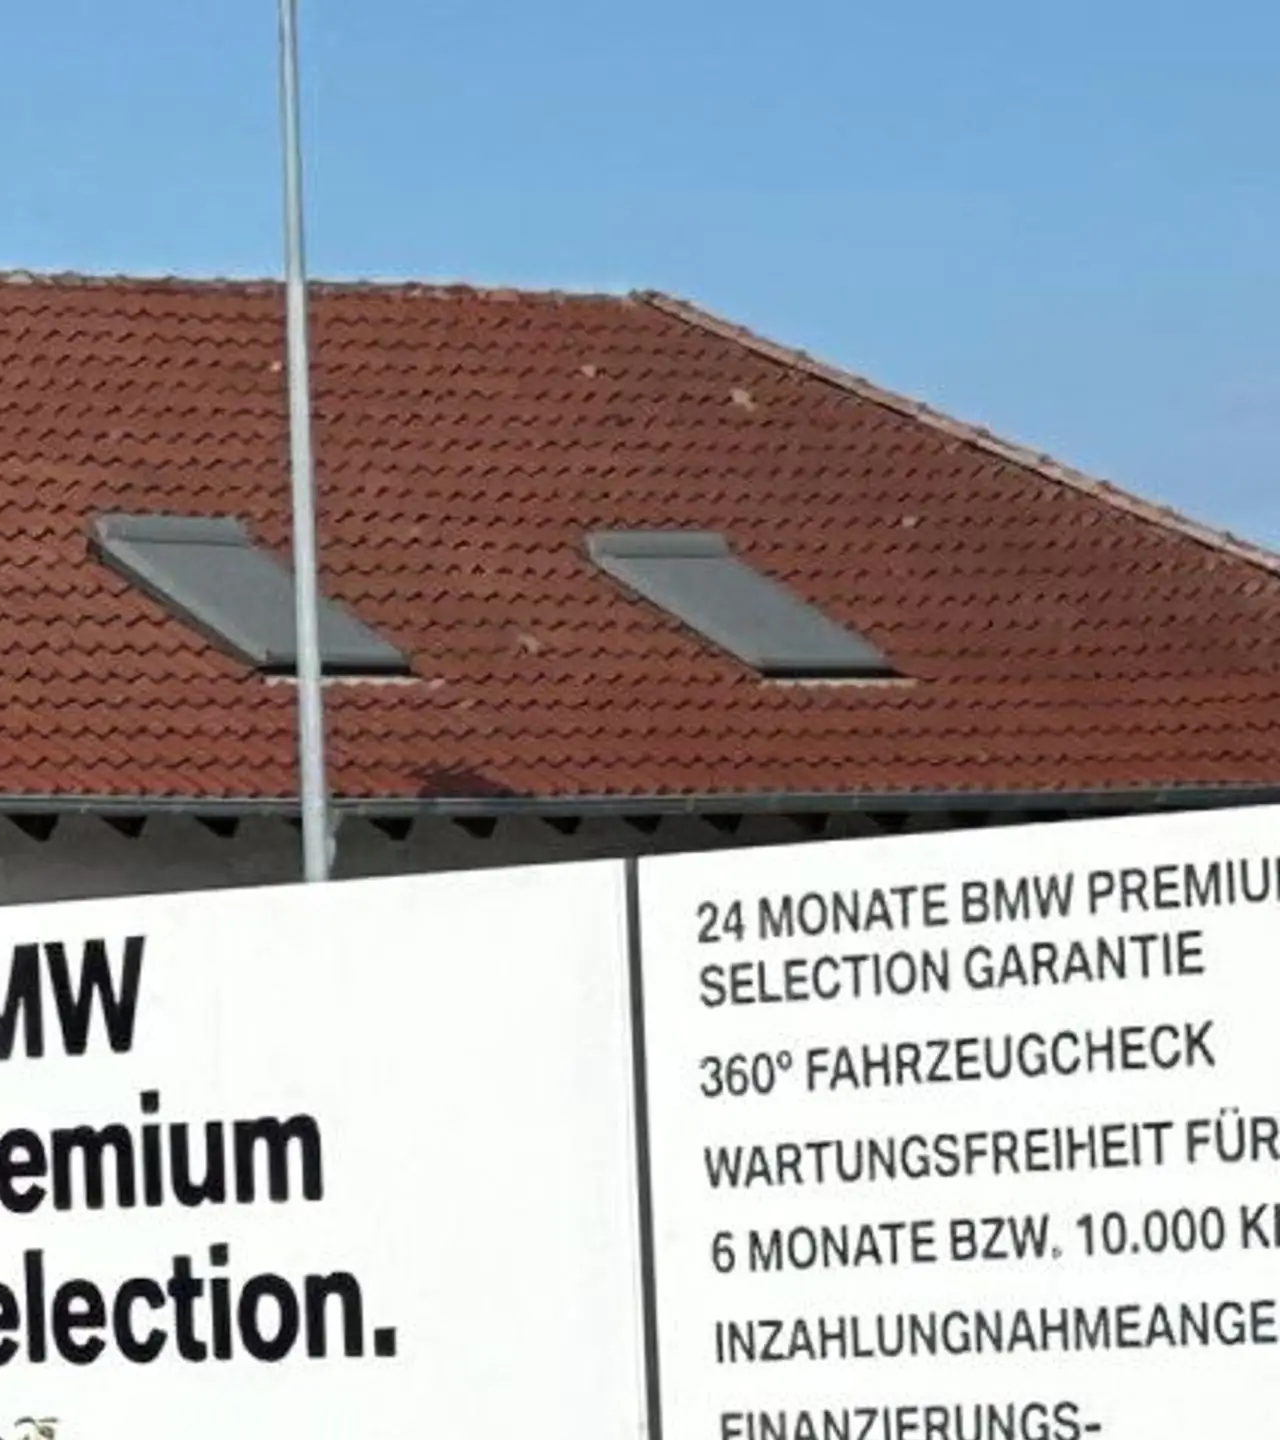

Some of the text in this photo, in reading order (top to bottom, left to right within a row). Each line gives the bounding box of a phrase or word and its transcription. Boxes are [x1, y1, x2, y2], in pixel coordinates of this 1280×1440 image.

[697, 856, 1280, 943] 24 MONATE BMW PREMIU
[700, 930, 1206, 1008] SELECTION GARANTIE
[807, 1020, 1216, 1092] FAHRZEUGCHECK
[704, 1107, 1280, 1189] WARTUNGSFREIHEIT FÜR
[711, 1203, 1280, 1274] 6 MONATE BZW. 10.000 K
